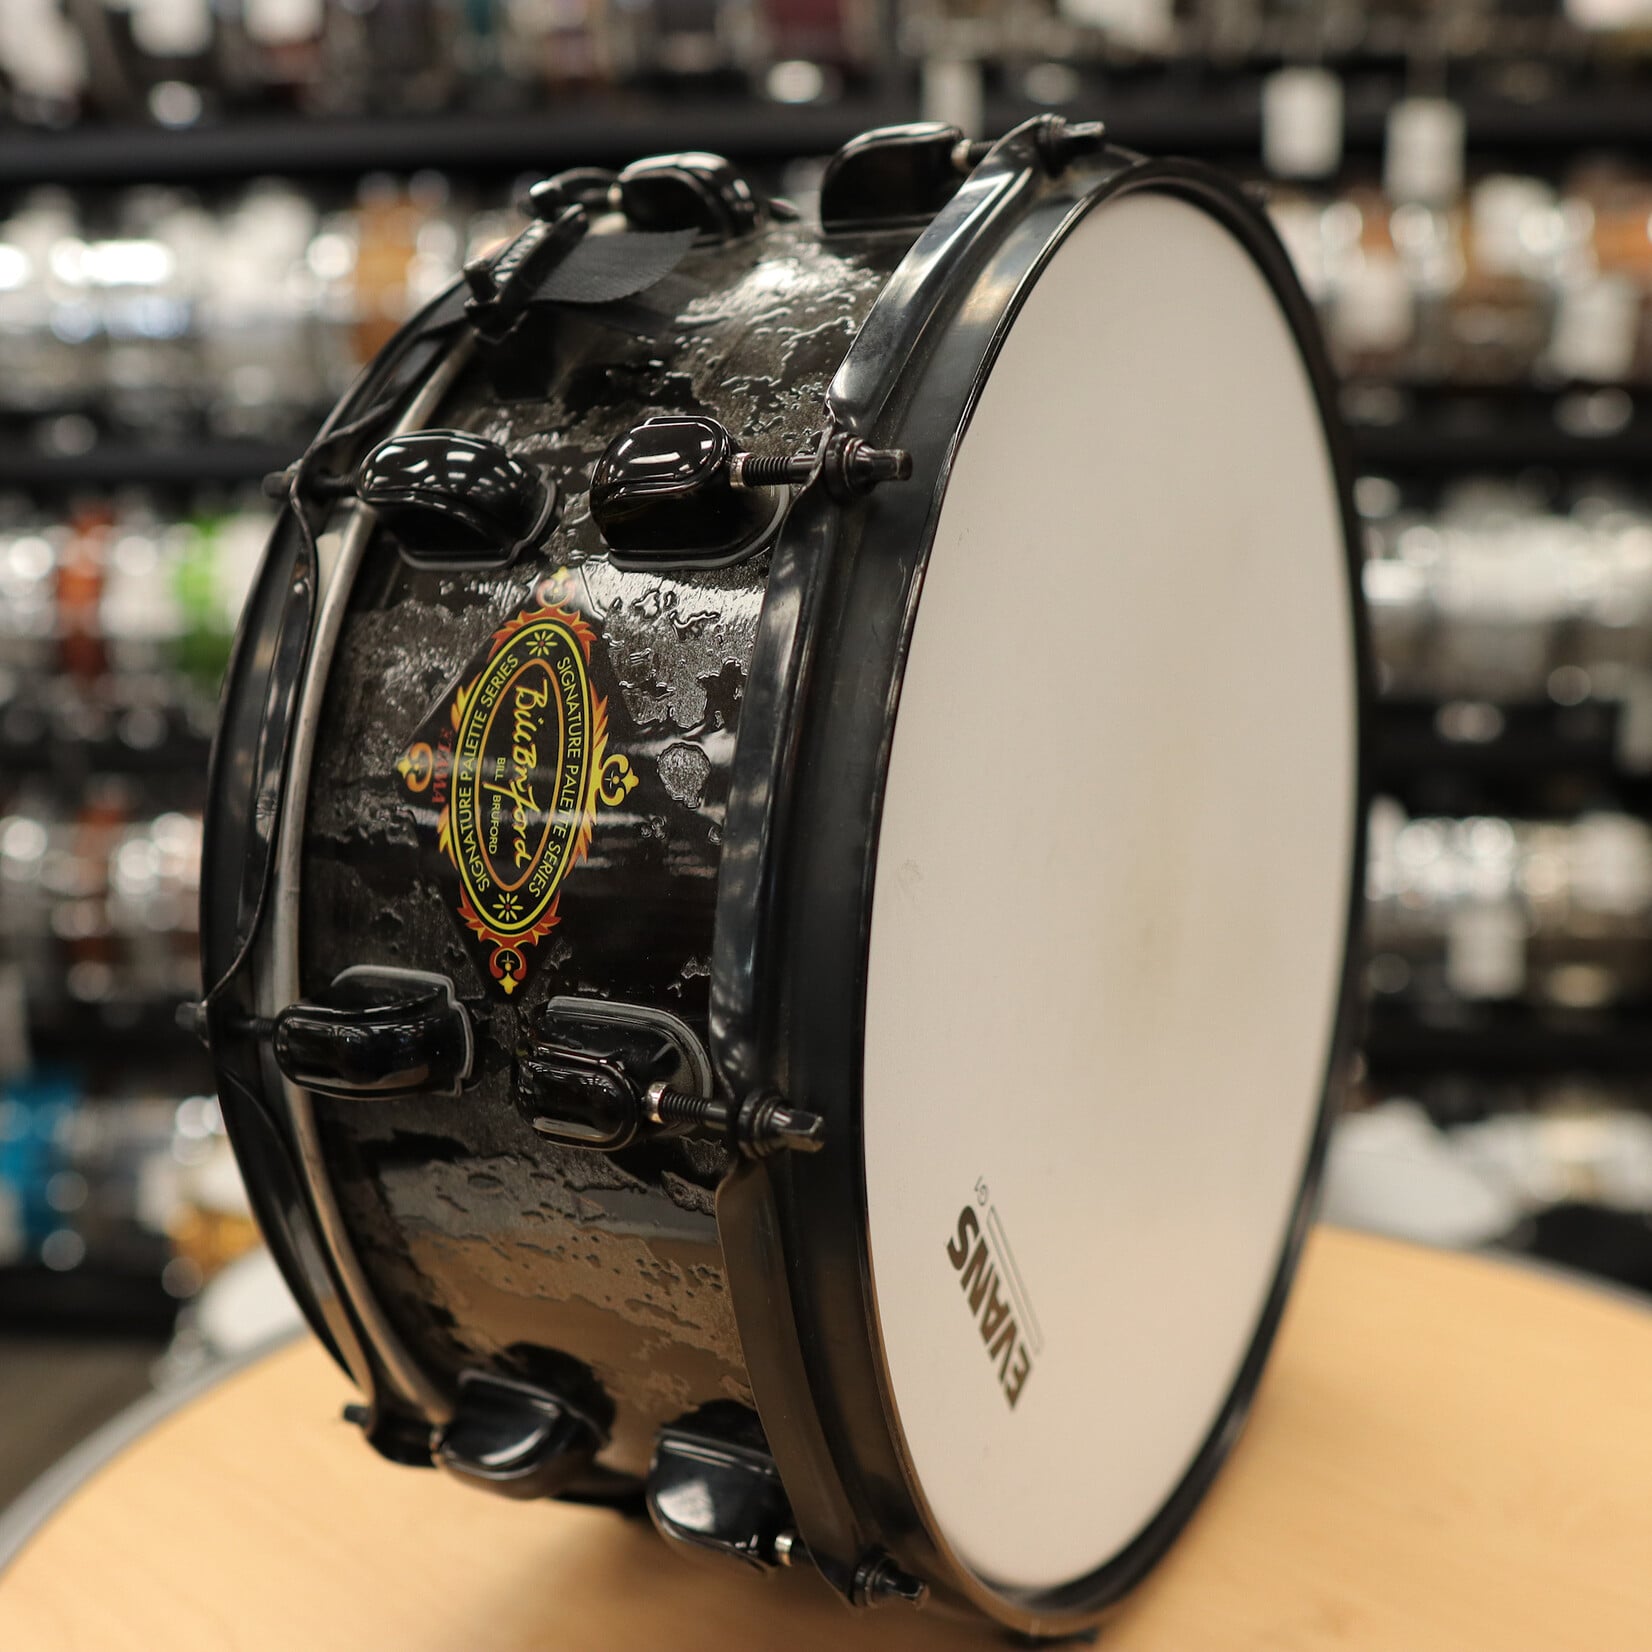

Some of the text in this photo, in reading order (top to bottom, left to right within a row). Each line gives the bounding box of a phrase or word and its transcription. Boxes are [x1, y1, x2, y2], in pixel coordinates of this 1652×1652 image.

[457, 653, 519, 893] SIGNATURE PALETTE SERIES
[488, 757, 506, 855] BILL BRUFORD
[528, 656, 582, 898] SIGNATURE PALETTE SERIES
[946, 1205, 1032, 1411] EVANS
